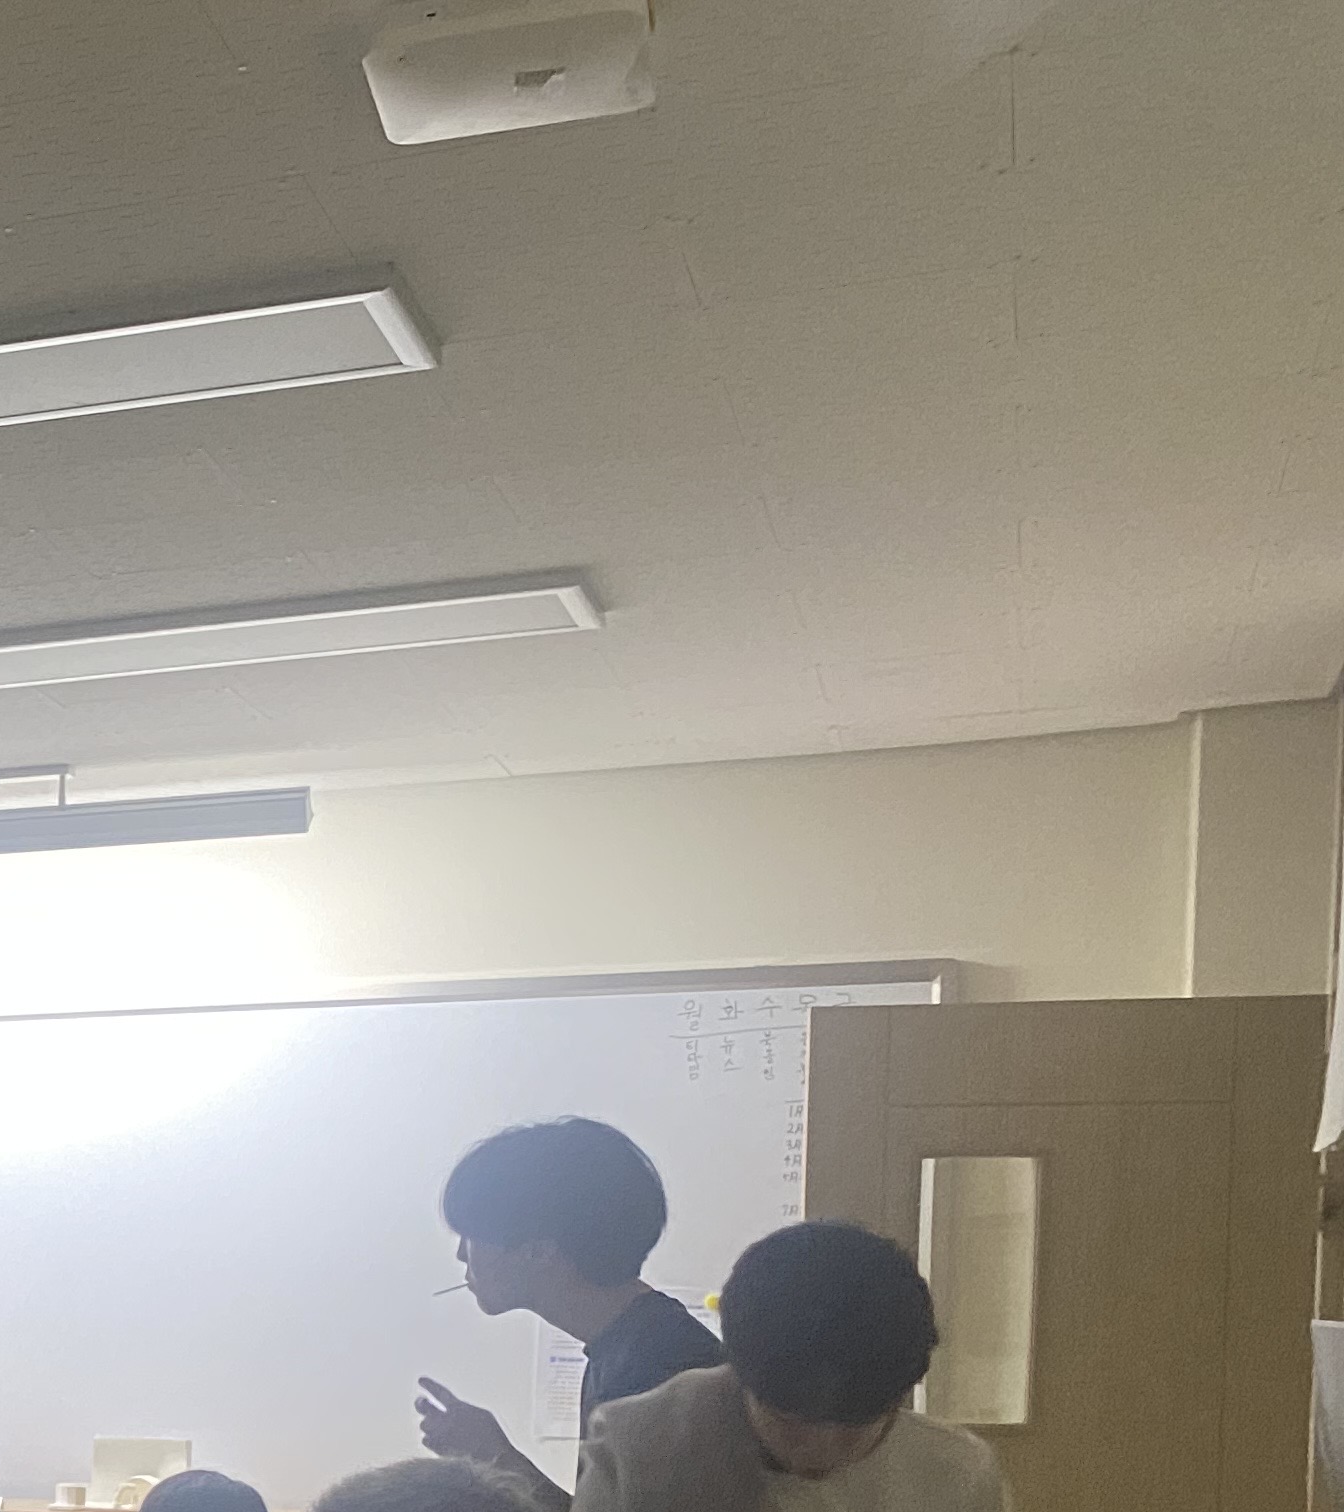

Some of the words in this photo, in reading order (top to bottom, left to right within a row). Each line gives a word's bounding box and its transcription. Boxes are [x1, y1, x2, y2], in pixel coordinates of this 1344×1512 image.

[677, 999, 702, 1031] 월
[718, 998, 745, 1021] 화
[756, 996, 783, 1018] 수
